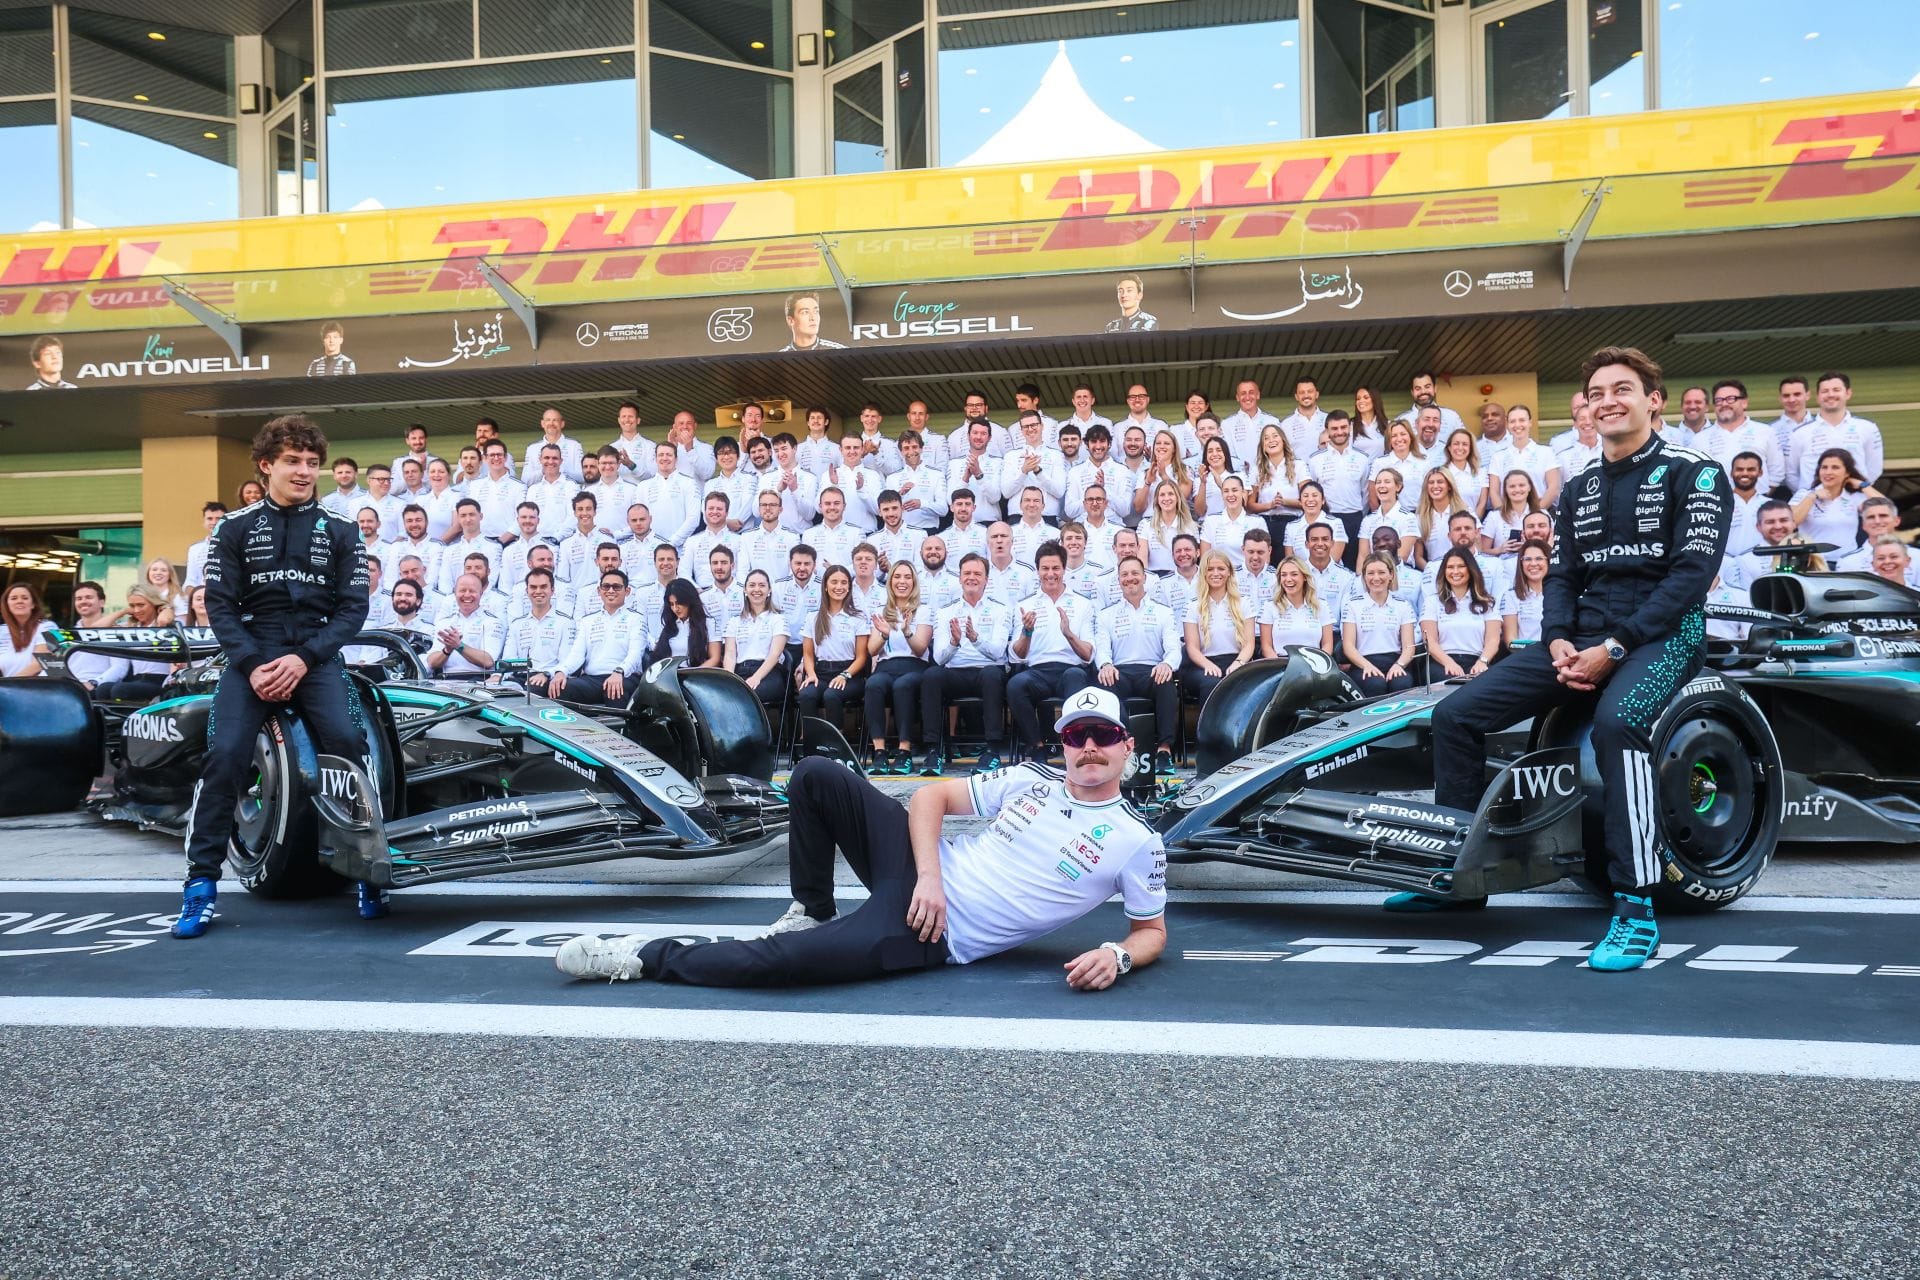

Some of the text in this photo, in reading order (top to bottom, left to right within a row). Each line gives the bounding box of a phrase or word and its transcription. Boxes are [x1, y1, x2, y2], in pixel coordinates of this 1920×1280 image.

[1763, 108, 1920, 202] D
[1039, 152, 1402, 251] DHL
[427, 201, 737, 292] DHL
[0, 241, 161, 315] HL
[1478, 278, 1533, 286] PETRONAS
[708, 307, 754, 343] 63
[893, 291, 960, 336] George
[603, 329, 649, 337] PETRONAS
[853, 316, 1034, 340] RUSSELL
[76, 355, 270, 379] ANTONELLI
[1690, 512, 1716, 524] IWC
[1581, 542, 1665, 563] PETONAS
[1708, 605, 1773, 620] CROWDSTRIKE
[1781, 643, 1826, 652] PETRONAS
[1681, 681, 1726, 697] PIRELLI
[122, 713, 184, 743] ETRONAS
[554, 750, 597, 784] Einhell
[1304, 744, 1369, 781] Einhell
[320, 767, 359, 801] IWC
[1510, 763, 1577, 801] IWC
[448, 800, 527, 823] PETRONAS
[1367, 803, 1456, 827] PETRONAS
[1783, 796, 1838, 821] nify
[448, 820, 530, 845] Syntium
[1356, 819, 1448, 851] Syntium
[1069, 838, 1101, 865] INEOS
